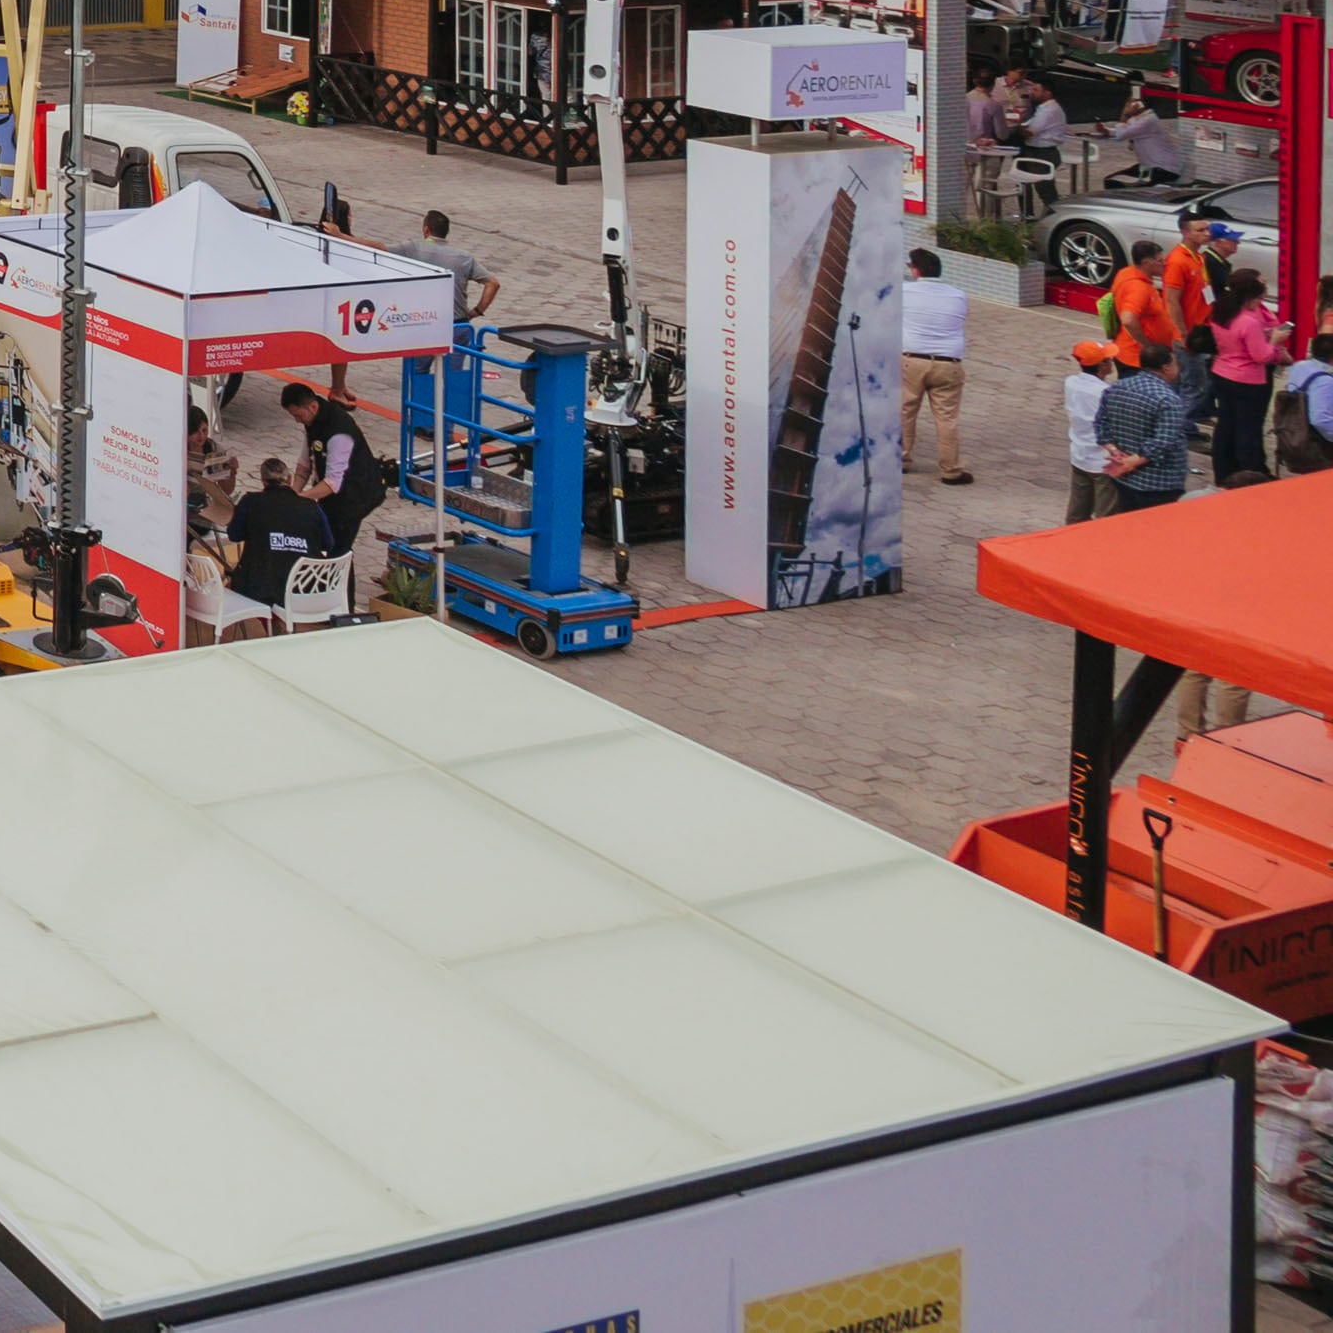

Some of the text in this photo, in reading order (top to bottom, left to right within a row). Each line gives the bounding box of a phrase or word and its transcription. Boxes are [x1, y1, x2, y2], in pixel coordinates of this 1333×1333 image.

[798, 73, 893, 93] AERORENTAL
[385, 311, 438, 324] AERORENTAL
[205, 340, 264, 353] SOMOS SU SOCIO
[205, 349, 254, 361] EN SEGURIDAD
[720, 238, 738, 511] www.aerorental.com.co
[110, 424, 152, 449] SOMOS SU
[102, 435, 160, 465] MEJOR ALIADO
[102, 449, 160, 479] PARA REALIZAR
[92, 457, 173, 499] TRABAJOS EN ALTURA
[270, 534, 309, 549] EN OBRA
